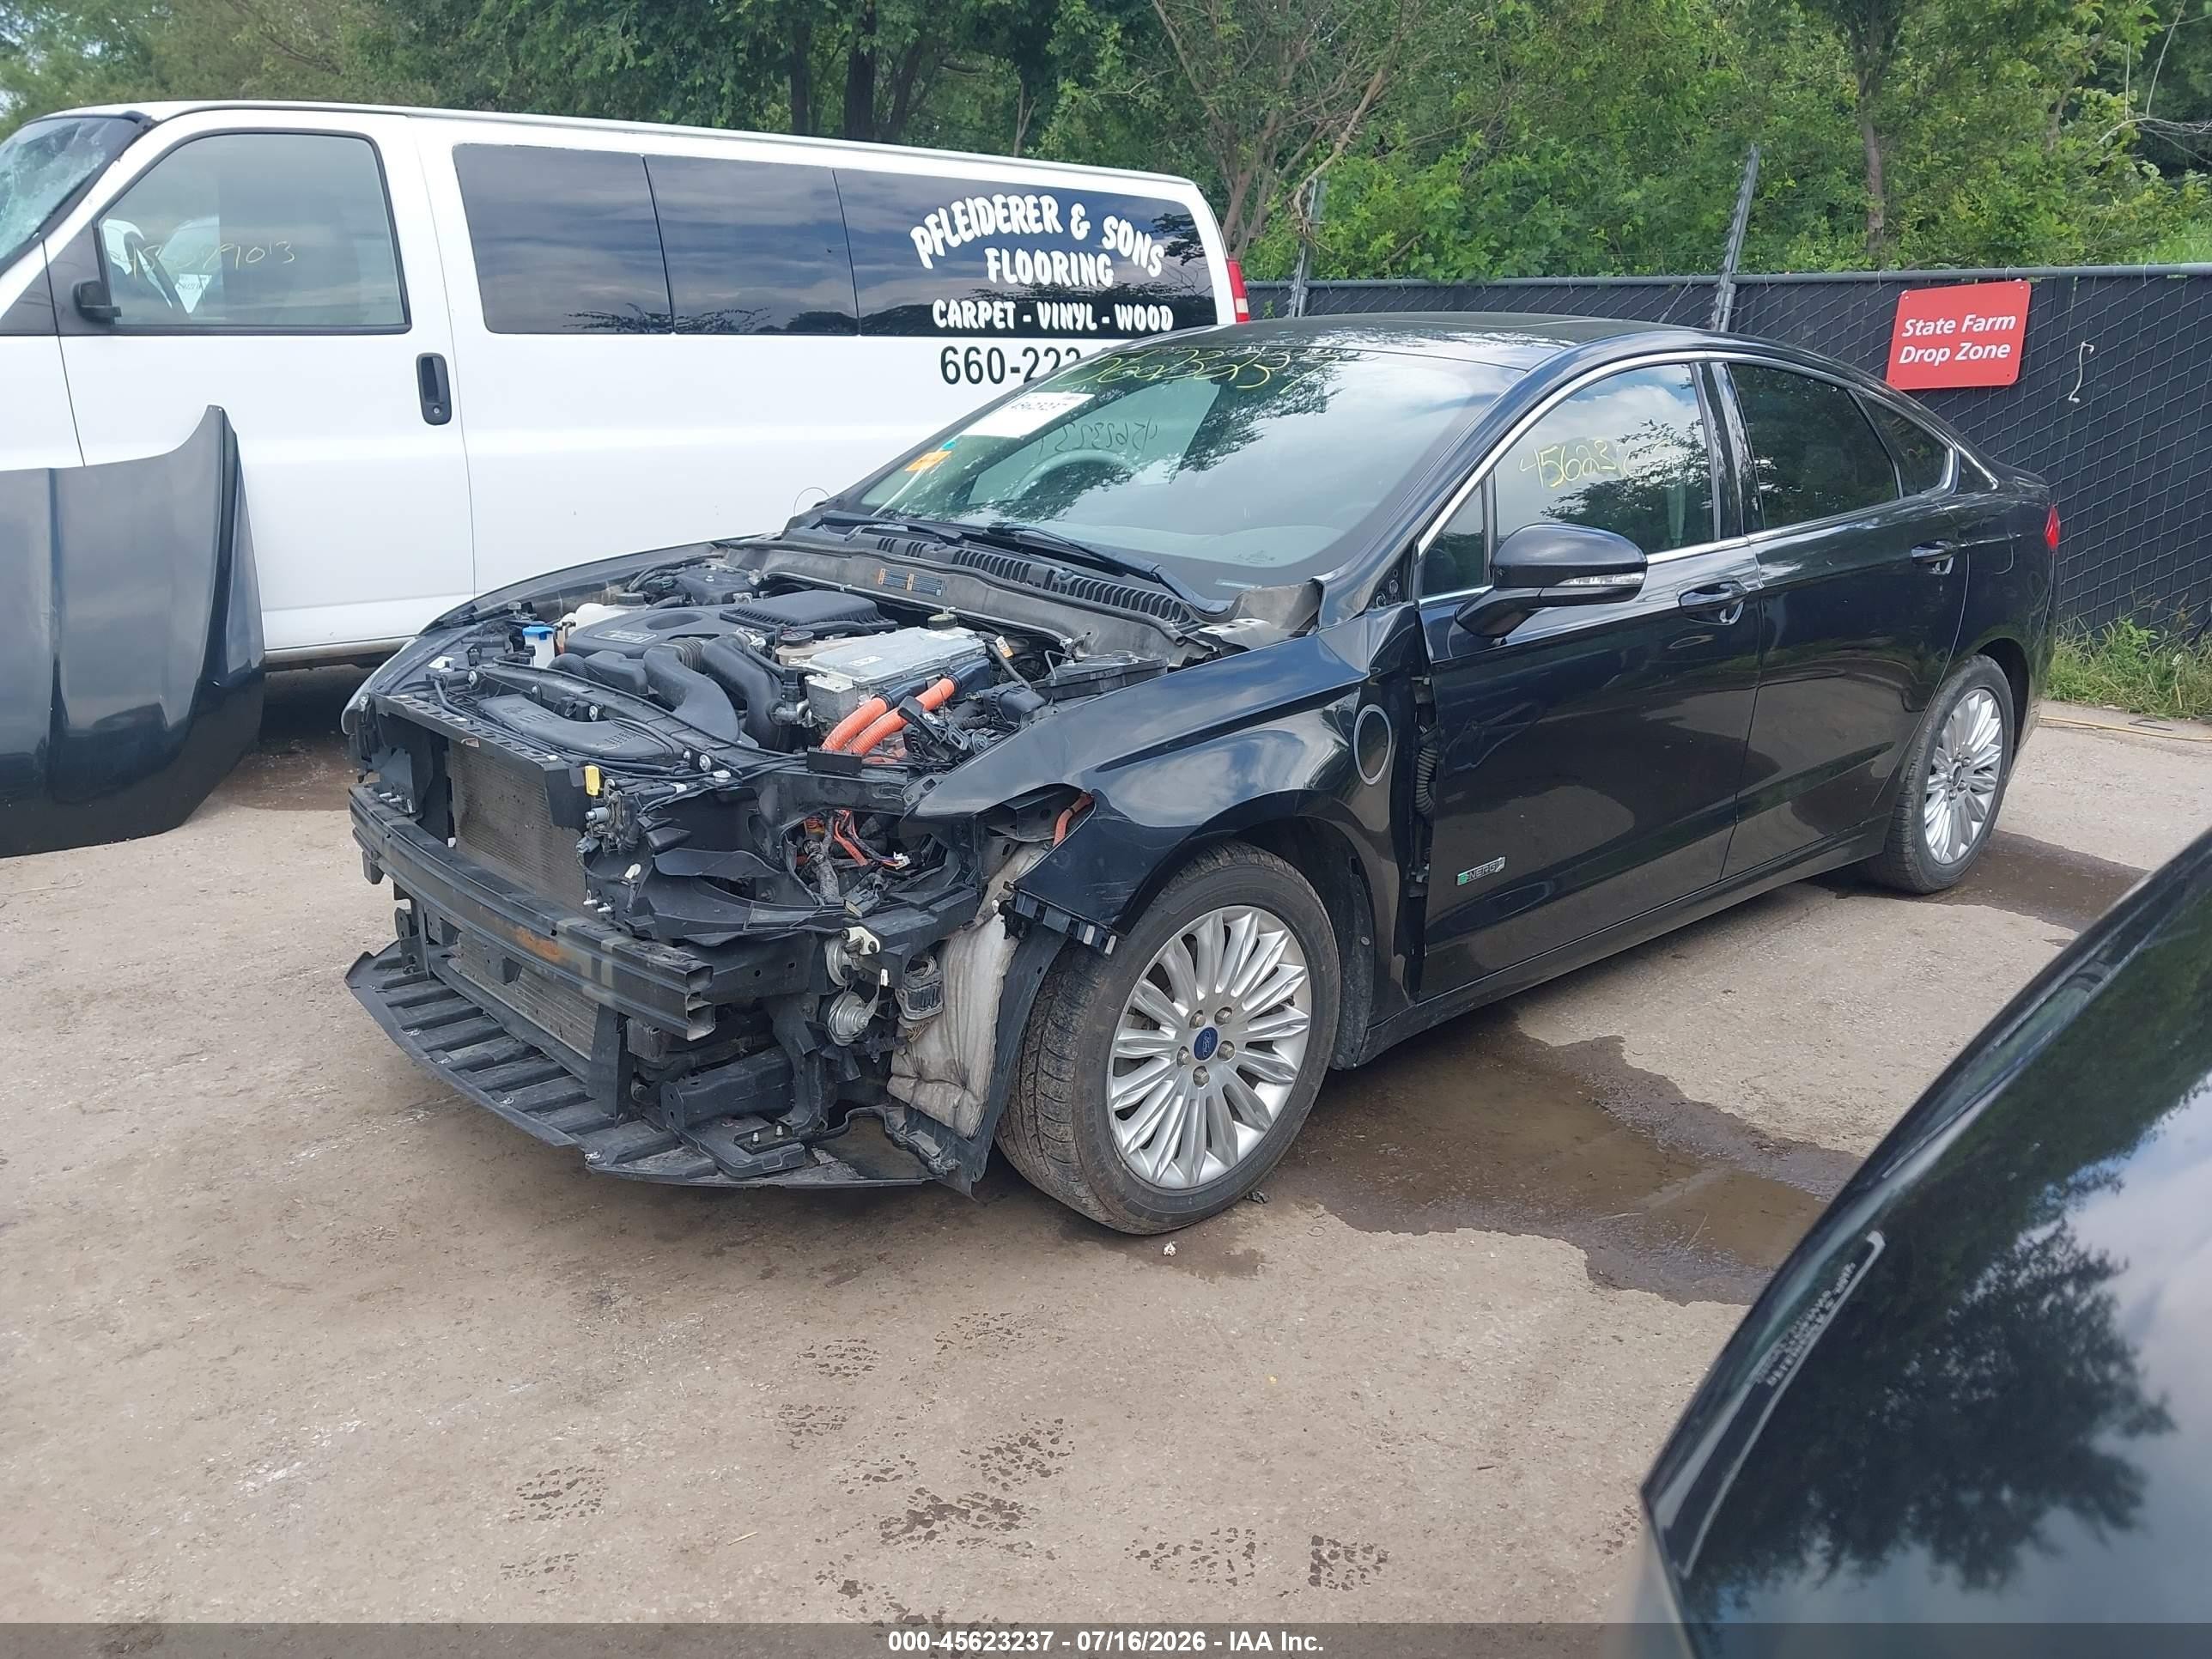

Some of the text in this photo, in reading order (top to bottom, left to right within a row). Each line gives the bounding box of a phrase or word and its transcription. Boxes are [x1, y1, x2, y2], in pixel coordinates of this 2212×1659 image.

[910, 193, 1165, 277] PFLEIDERER & SONS
[984, 247, 1115, 288] FLOORING
[933, 299, 1017, 330] CARPET
[1036, 301, 1098, 331] VINYL
[1114, 304, 1174, 331] WOOD
[1901, 313, 2016, 337] State Farm
[1899, 342, 2011, 367] Drop Zone
